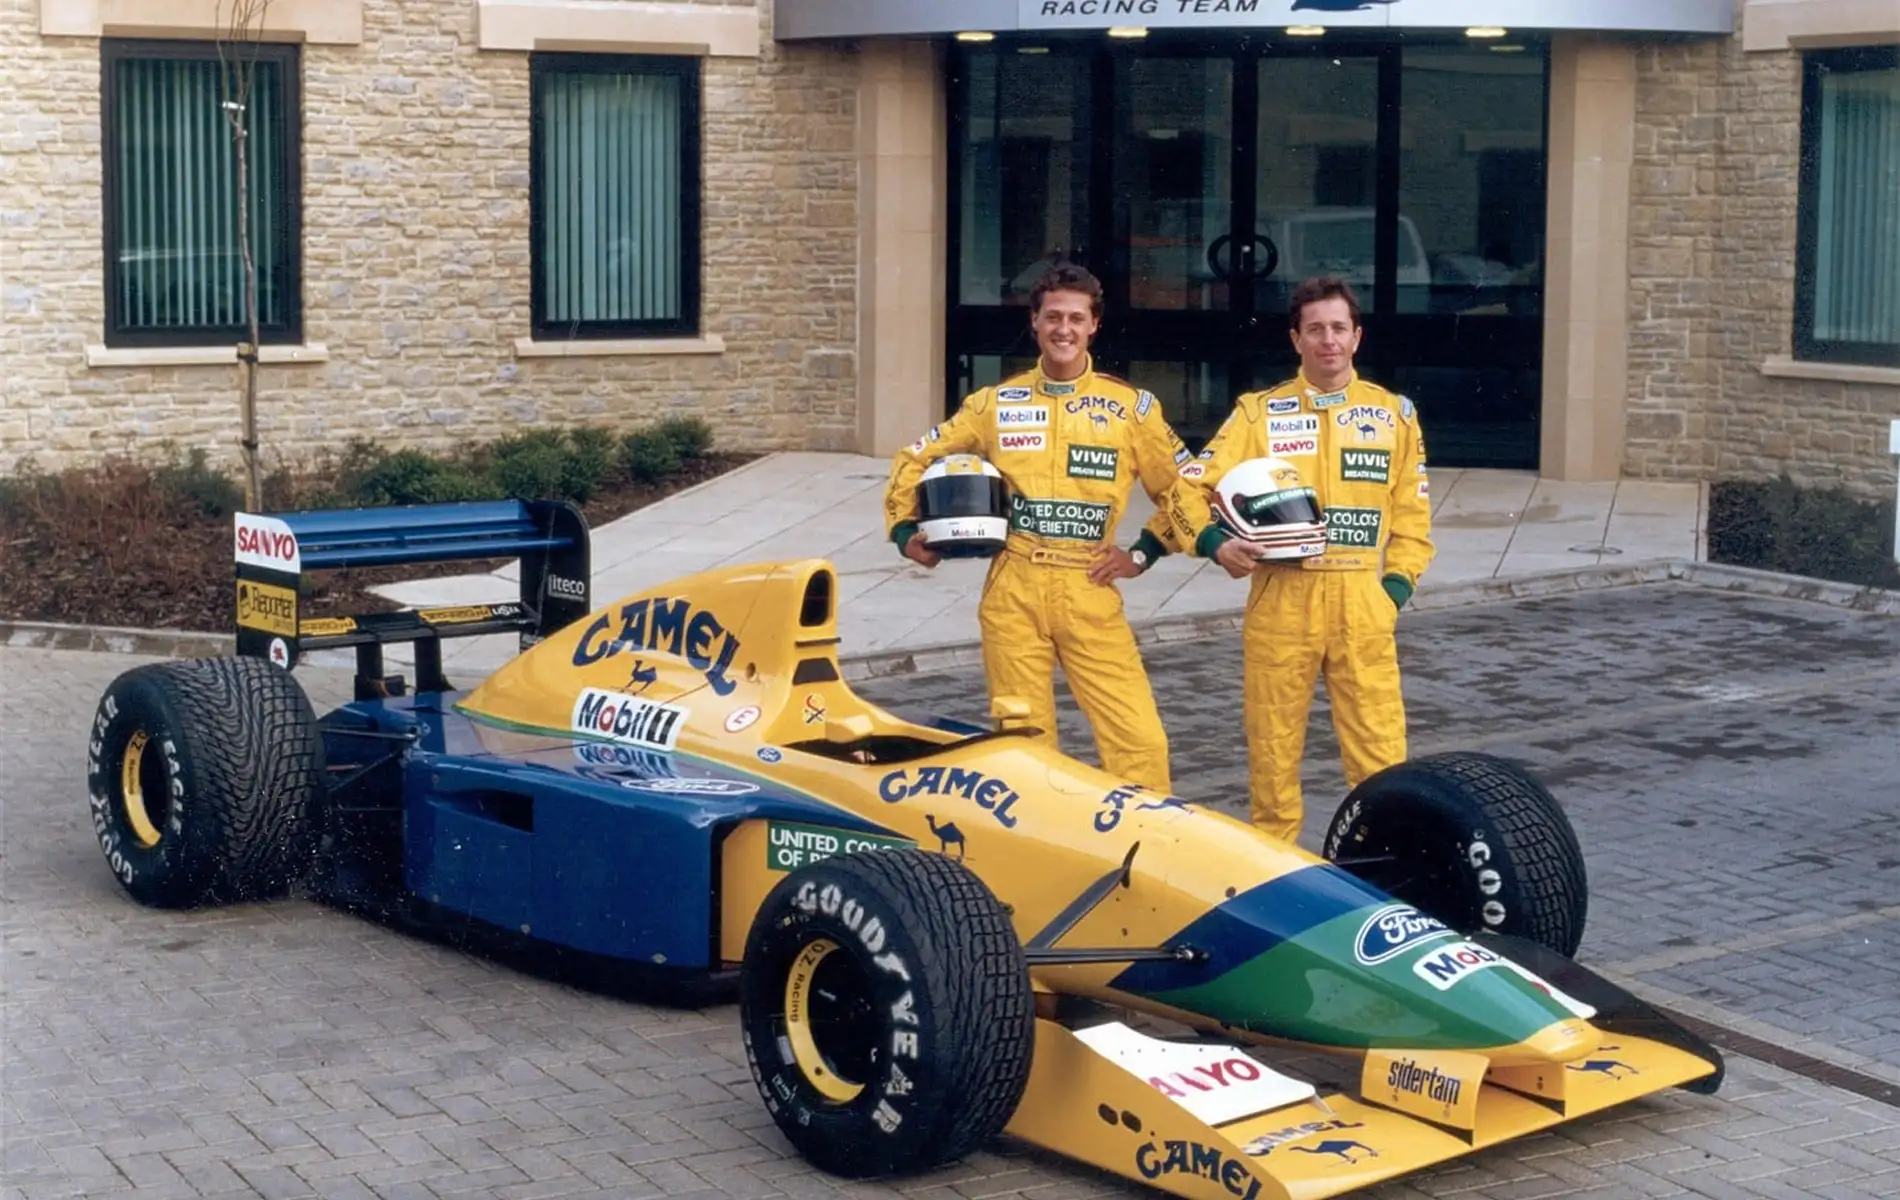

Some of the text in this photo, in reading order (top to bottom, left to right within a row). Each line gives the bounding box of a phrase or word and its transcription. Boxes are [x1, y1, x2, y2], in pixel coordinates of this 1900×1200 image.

[1041, 0, 1259, 15] RACING TEAM
[1000, 411, 1032, 423] Mobil
[1065, 396, 1127, 420] CAMEL
[1337, 407, 1394, 428] CAMEL
[1271, 420, 1303, 432] Mobil
[1001, 436, 1041, 447] SANYO
[1273, 441, 1314, 452] SANYO
[238, 526, 295, 561] SANYO
[552, 575, 585, 595] iteco
[572, 597, 741, 696] CAMEL
[578, 693, 680, 745] Mobil 1
[879, 767, 1020, 828] CAMEL
[770, 828, 839, 853] UNITED
[778, 849, 803, 867] OF
[798, 881, 920, 1134] GOODYEAR
[1148, 1058, 1260, 1099] ANYO
[1387, 1057, 1461, 1105] sidertam
